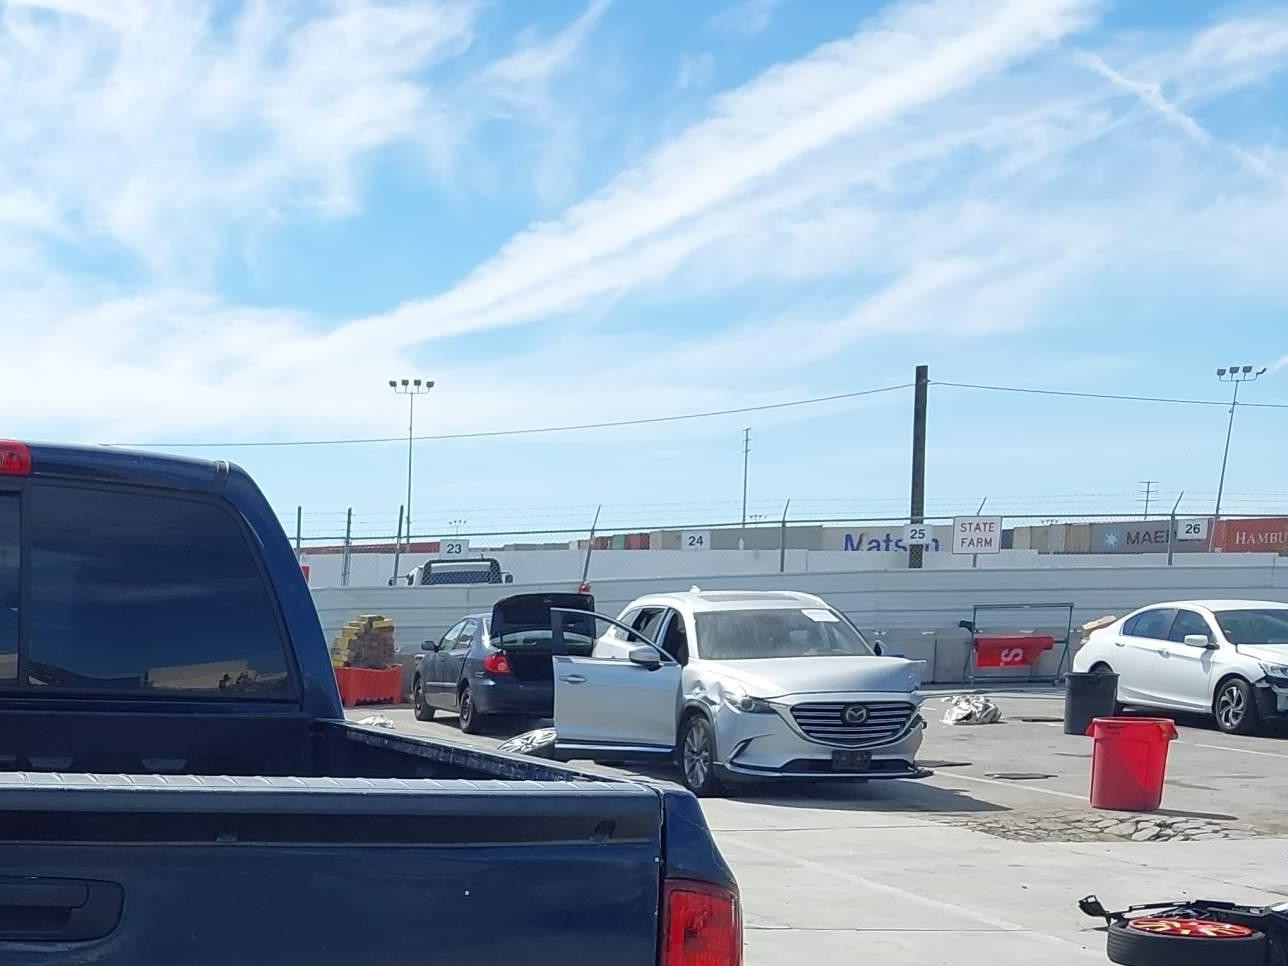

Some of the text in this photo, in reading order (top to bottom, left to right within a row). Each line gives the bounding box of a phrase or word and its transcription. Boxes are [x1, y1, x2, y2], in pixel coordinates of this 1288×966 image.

[960, 522, 996, 533] STATE
[1185, 523, 1201, 535] 26
[910, 528, 926, 540] 25
[688, 535, 704, 547] 24
[844, 532, 940, 552] Matsn
[960, 537, 993, 548] FARM
[446, 543, 462, 554] 23
